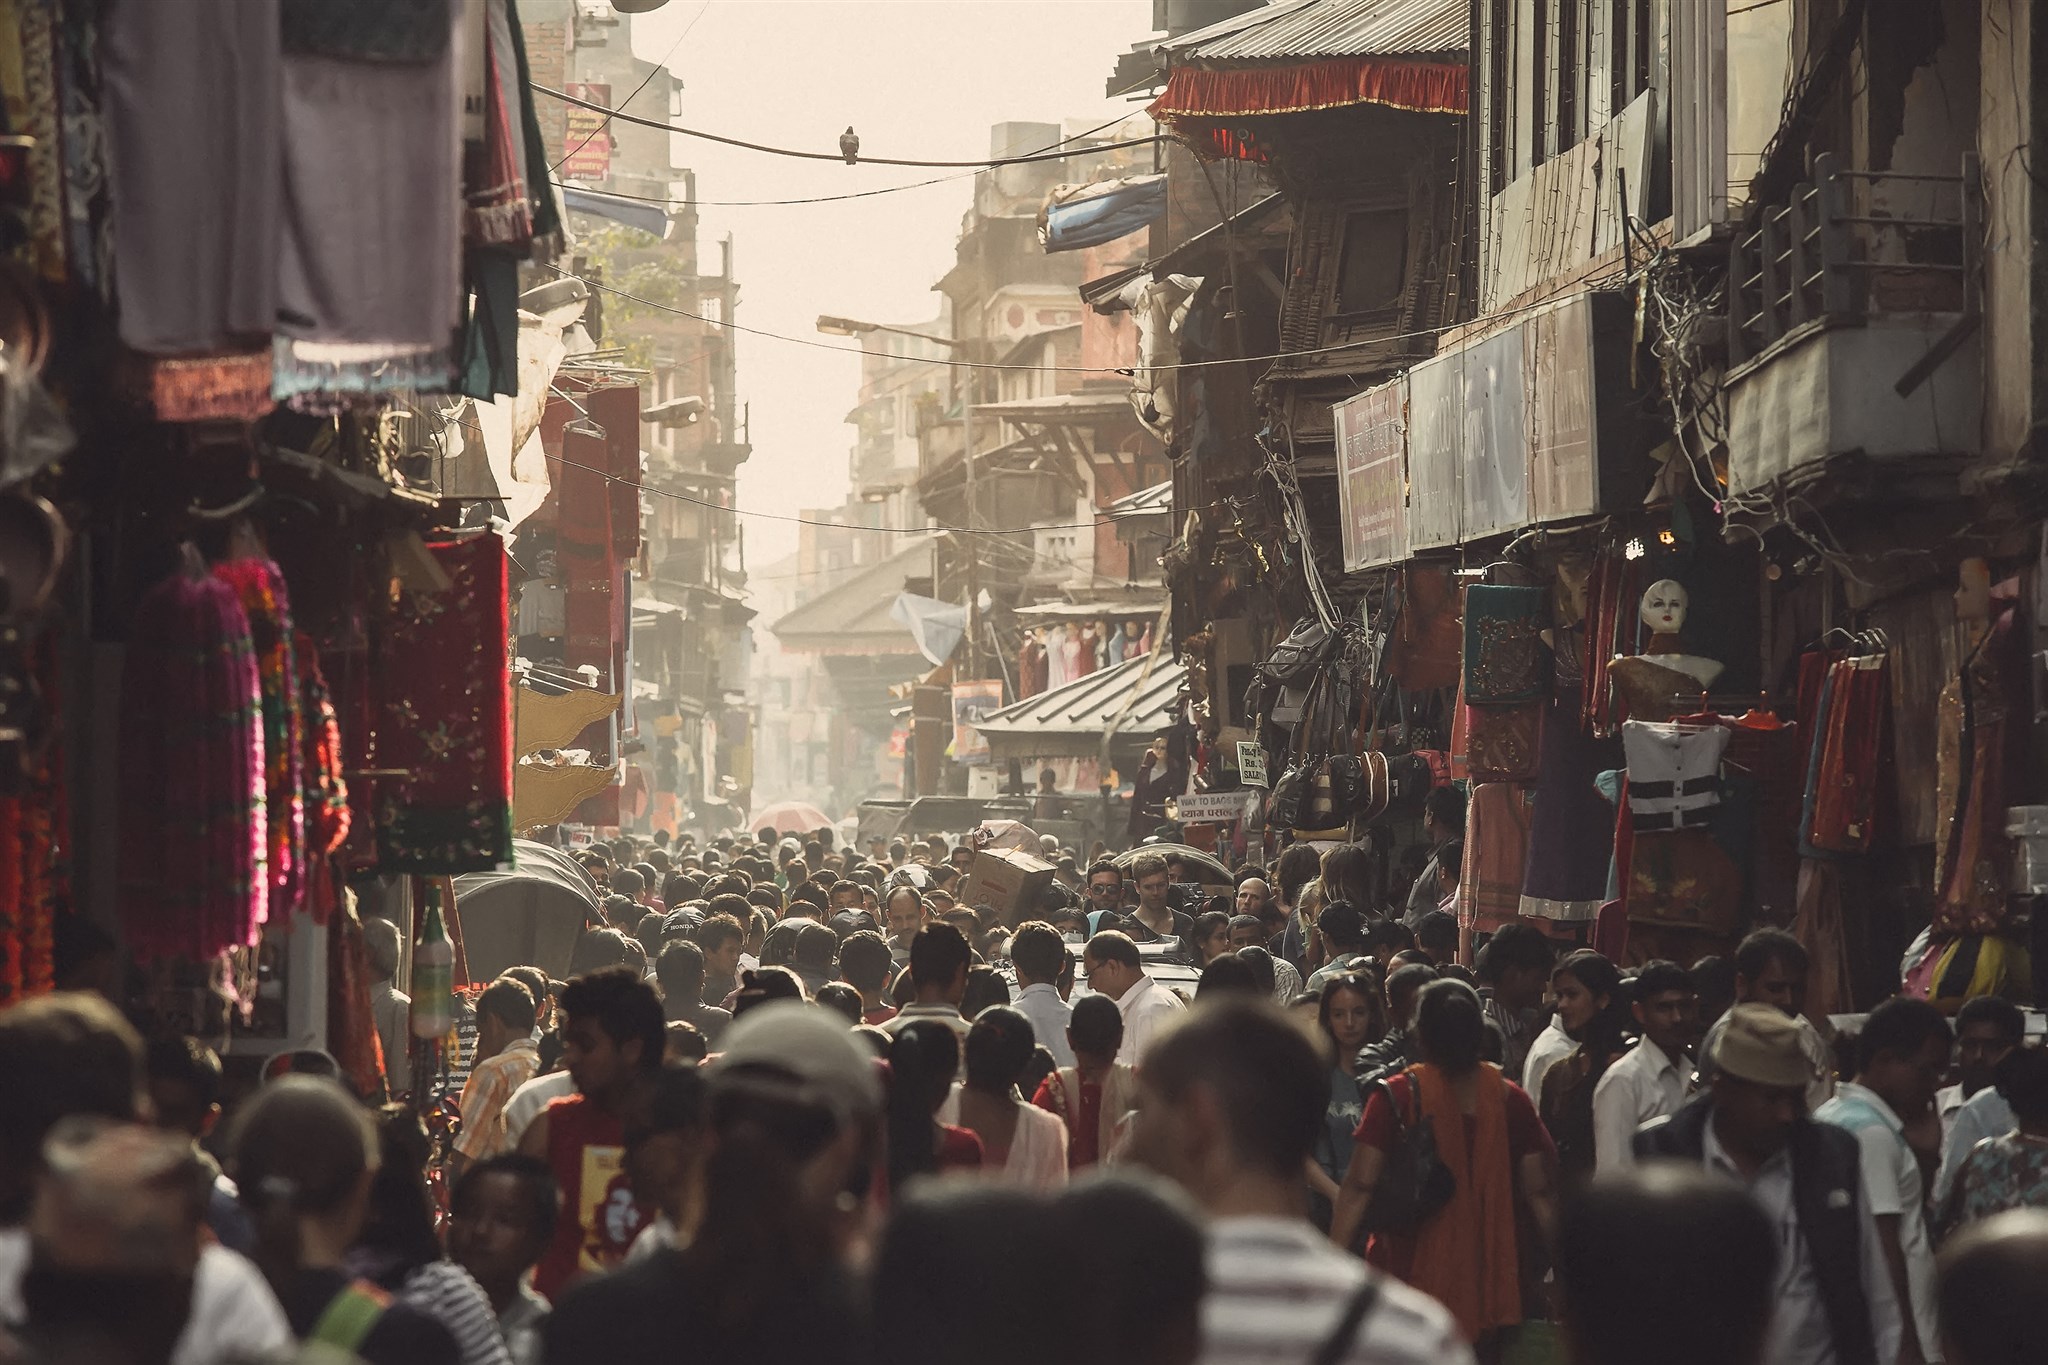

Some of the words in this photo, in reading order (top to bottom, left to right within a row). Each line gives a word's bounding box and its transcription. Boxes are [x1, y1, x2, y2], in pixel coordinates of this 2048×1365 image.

[568, 160, 603, 170] Centre
[1181, 798, 1197, 806] WAY
[1199, 797, 1208, 805] TO
